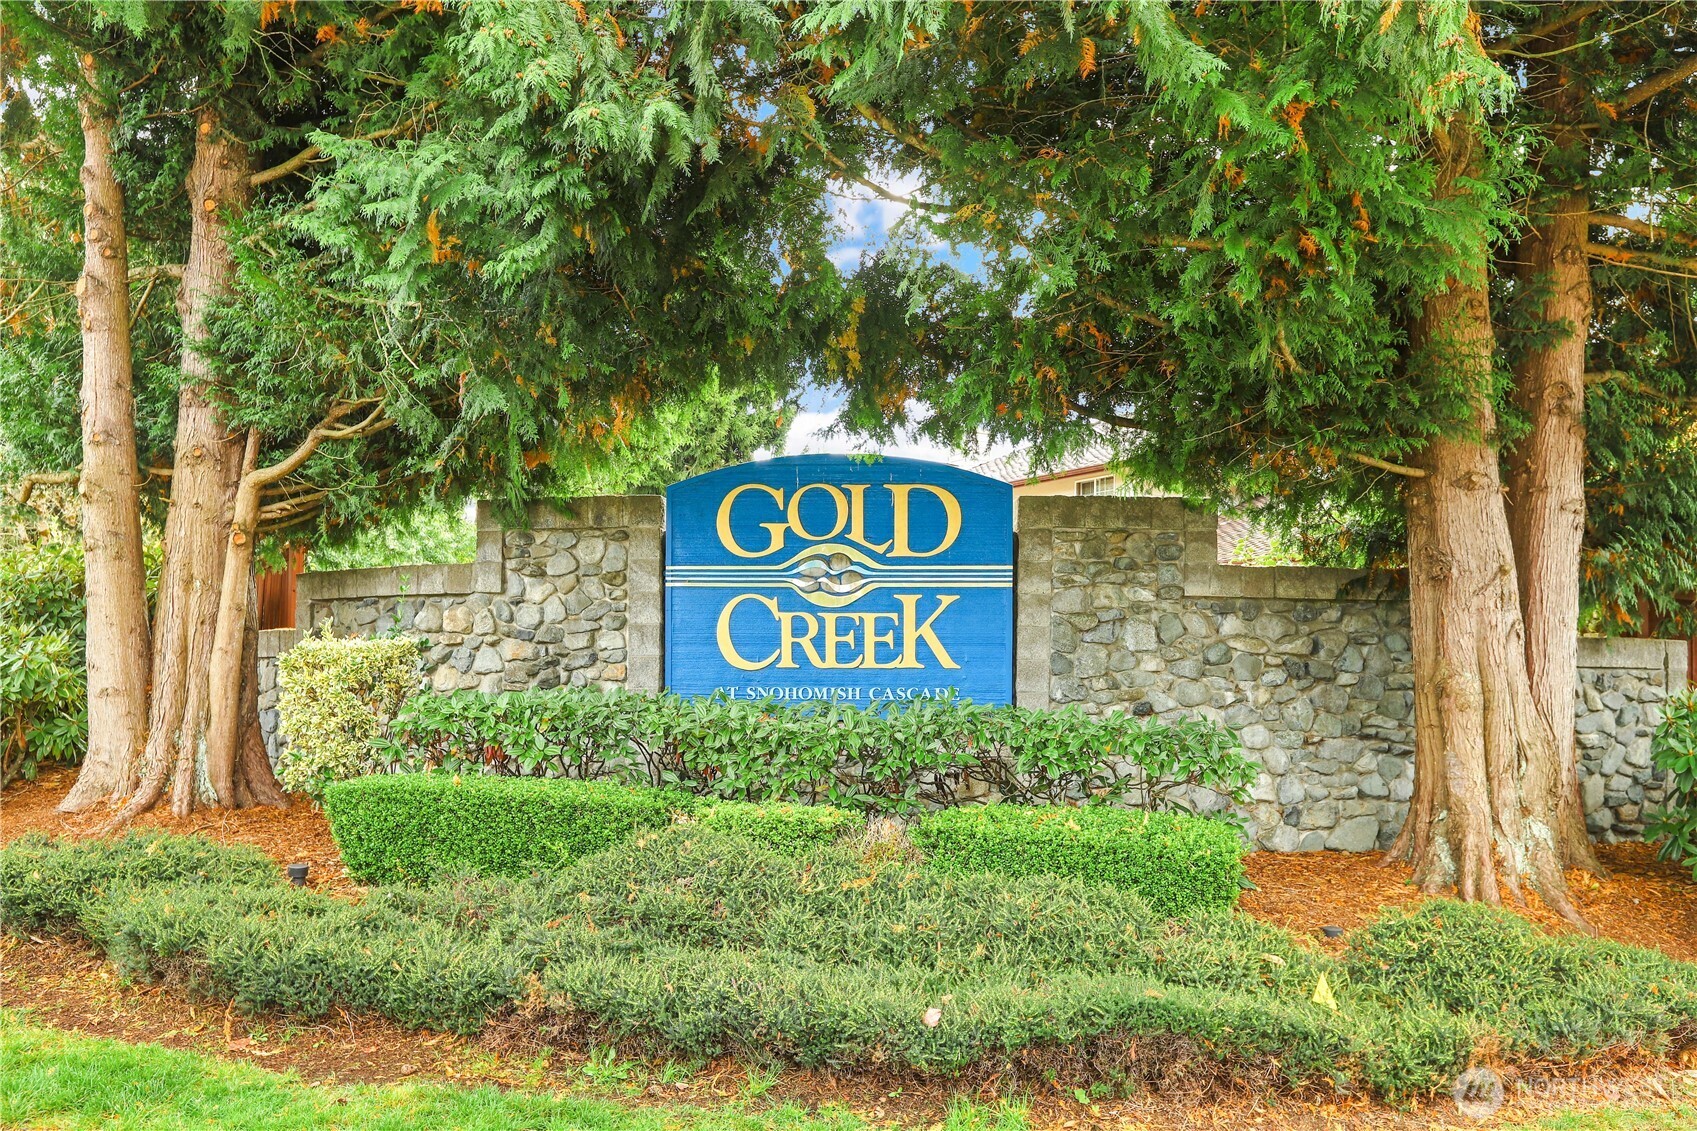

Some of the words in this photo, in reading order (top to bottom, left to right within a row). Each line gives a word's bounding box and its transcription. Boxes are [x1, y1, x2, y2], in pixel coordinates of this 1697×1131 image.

[716, 483, 962, 558] GOLD
[716, 593, 961, 671] CREEK
[746, 686, 862, 700] SNOHOMISH
[868, 686, 961, 700] CASCADE
